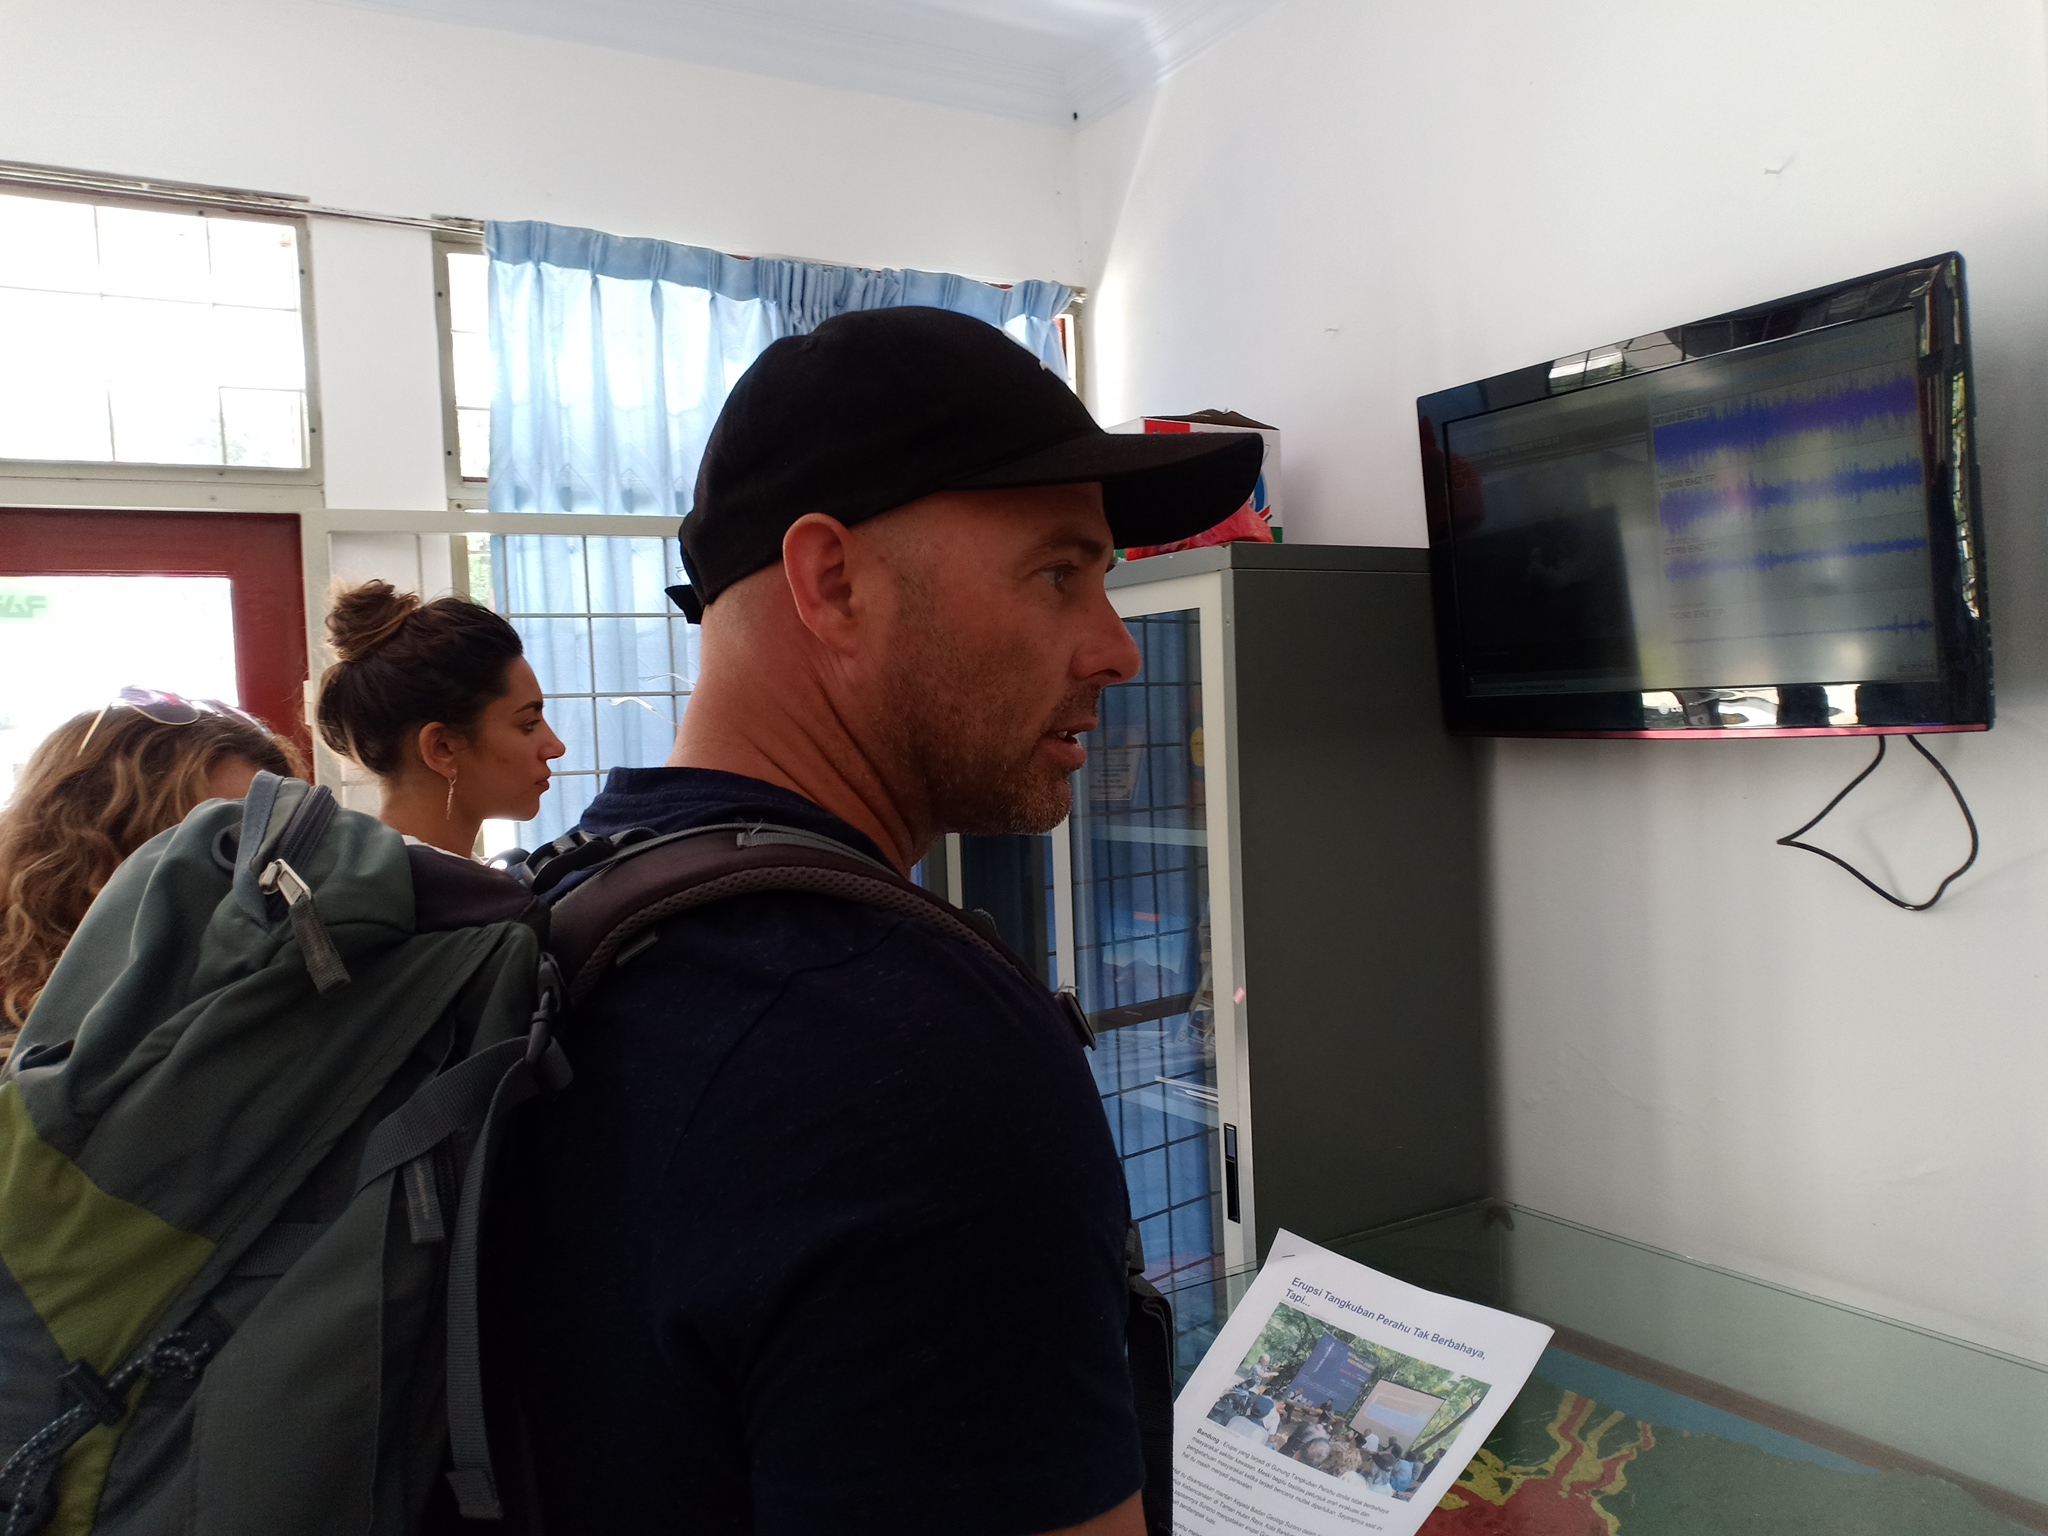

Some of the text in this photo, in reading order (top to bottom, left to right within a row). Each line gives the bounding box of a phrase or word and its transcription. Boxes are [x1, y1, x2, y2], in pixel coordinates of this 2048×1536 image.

[1286, 1289, 1309, 1306] Tapi...
[1292, 1277, 1323, 1296] Erupsi
[1325, 1291, 1374, 1318] Tangkuban
[1376, 1314, 1411, 1333] Perahu
[1414, 1327, 1429, 1339] Tak
[1431, 1334, 1484, 1358] Berbahaya,
[1182, 1451, 1190, 1459] hal
[1196, 1460, 1210, 1468] masih
[1211, 1467, 1229, 1478] menjadi
[1229, 1476, 1252, 1489] persoalan.
[1186, 1445, 1216, 1461] pengetahuan
[1217, 1460, 1244, 1475] masyarakat
[1244, 1473, 1258, 1482] ketika
[1259, 1479, 1273, 1489] terjadi
[1274, 1486, 1294, 1499] bencana
[1338, 1512, 1364, 1525] Sayangnya
[1192, 1437, 1219, 1452] masyarakat
[1219, 1451, 1235, 1460] sekitar
[1235, 1458, 1255, 1471] kawasan.
[1257, 1468, 1271, 1478] Meski
[1272, 1475, 1287, 1485] begitu
[1287, 1482, 1305, 1493] fasilitas
[1305, 1491, 1326, 1502] petunjuk
[1338, 1504, 1359, 1514] evakuasi
[1197, 1428, 1220, 1444] Bandung
[1223, 1441, 1238, 1452] Erupsi
[1238, 1450, 1250, 1459] yang
[1250, 1455, 1265, 1465] terjadi
[1271, 1464, 1290, 1477] Gunung
[1292, 1473, 1317, 1487] Tangkuban
[1318, 1485, 1335, 1496] Perahu
[1363, 1503, 1389, 1514] berbahaya
[1179, 1503, 1205, 1518] berdampak
[1187, 1476, 1215, 1491] disampaikan
[1215, 1490, 1233, 1501] mantan
[1233, 1498, 1250, 1510] Kepala
[1250, 1506, 1266, 1516] Badan
[1266, 1513, 1284, 1525] Geologi
[1284, 1521, 1302, 1532] Surono
[1199, 1502, 1216, 1514] Surono
[1216, 1512, 1244, 1527] mengatakan
[1245, 1526, 1259, 1534] erupsi
[1219, 1502, 1235, 1512] Taman
[1236, 1510, 1250, 1520] Hutan
